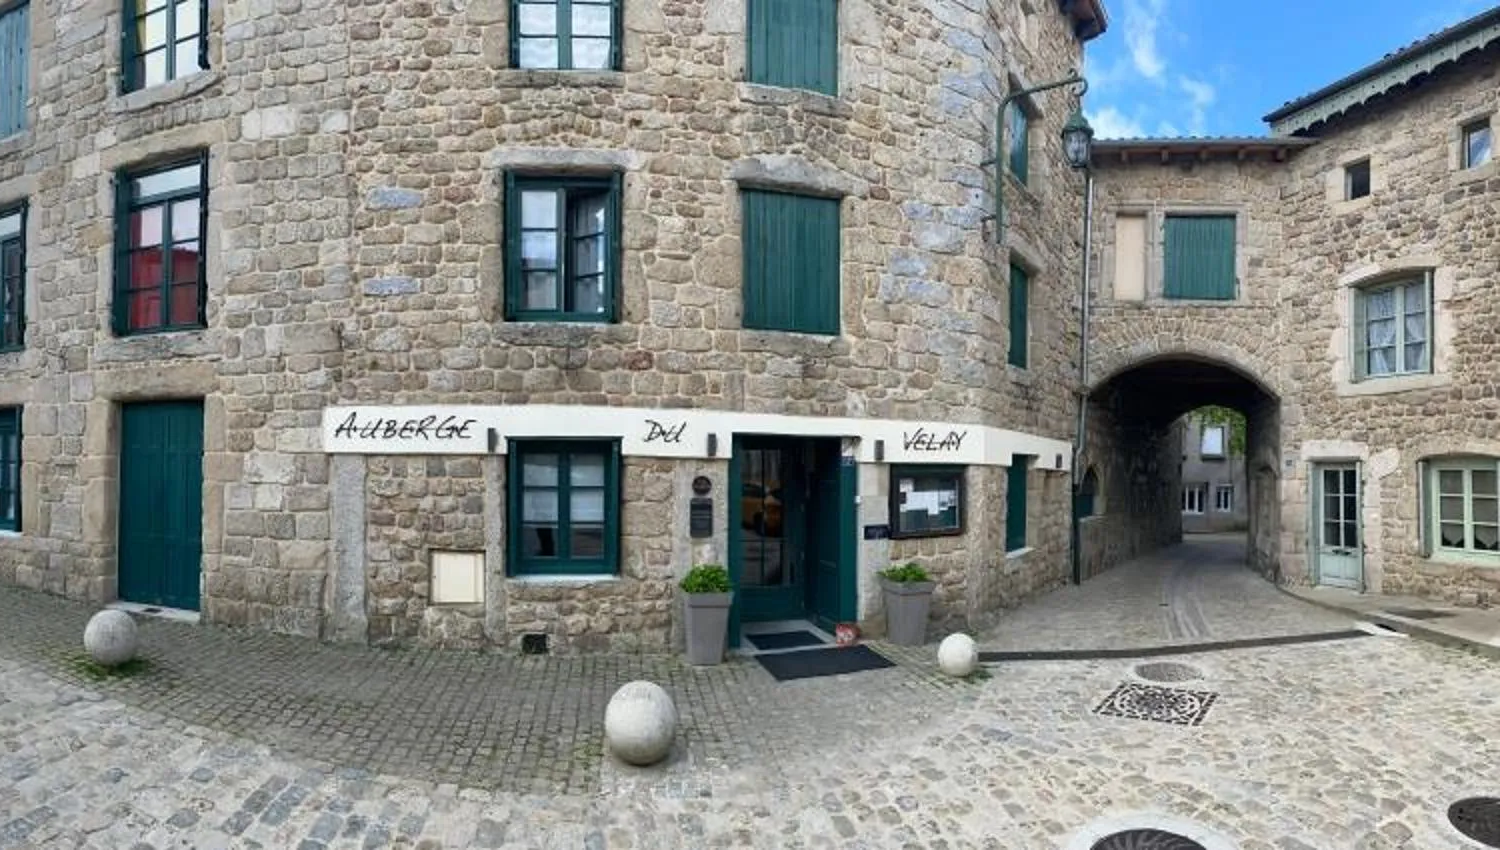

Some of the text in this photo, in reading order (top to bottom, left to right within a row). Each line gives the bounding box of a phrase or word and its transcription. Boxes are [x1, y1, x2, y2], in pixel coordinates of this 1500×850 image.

[334, 411, 967, 451] AUBERGE DU VELAY
